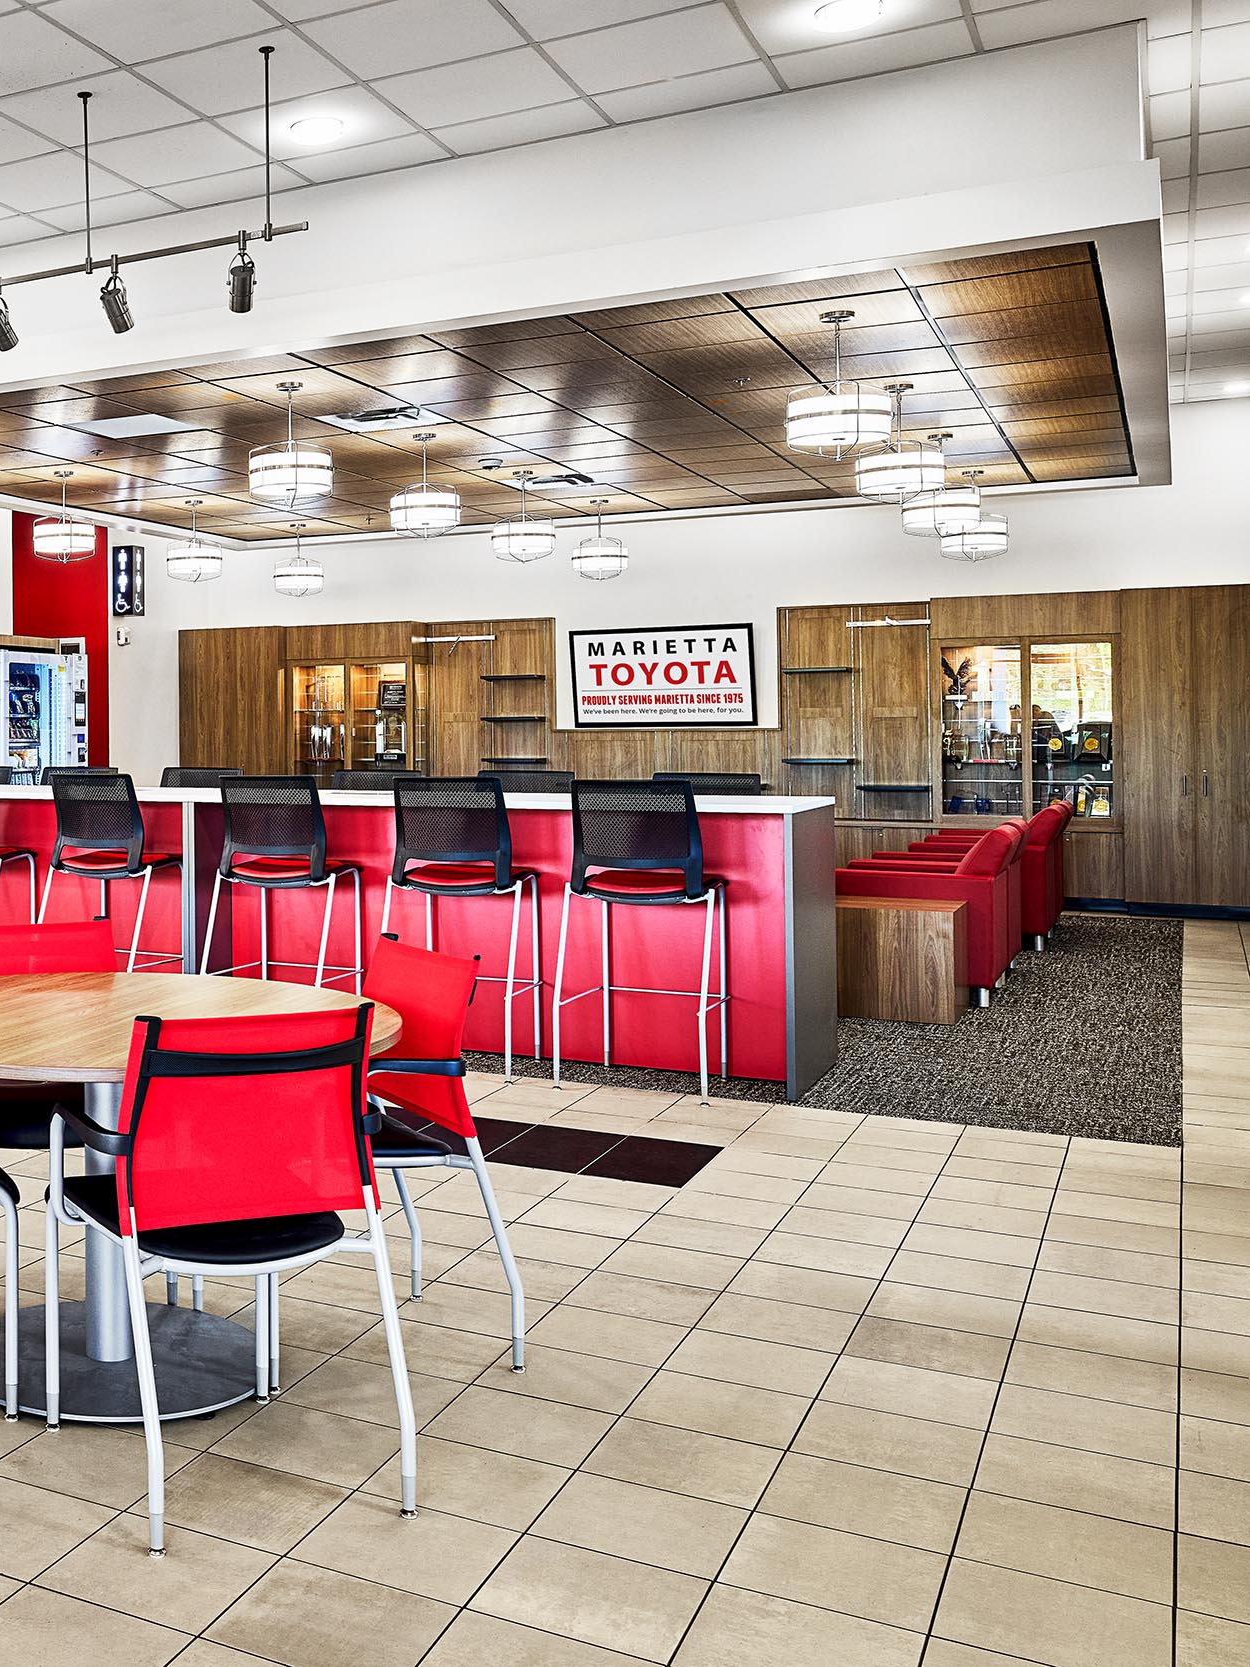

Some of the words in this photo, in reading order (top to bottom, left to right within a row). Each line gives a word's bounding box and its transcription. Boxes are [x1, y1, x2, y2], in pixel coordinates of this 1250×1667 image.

[588, 637, 738, 657] MARIETTA
[589, 660, 738, 687] TOYOTA
[582, 695, 617, 706] PROUDLY
[618, 694, 653, 705] SERVING
[654, 693, 695, 705] MARIETTA
[696, 693, 721, 704] SINCE
[723, 693, 744, 704] 1975
[658, 708, 678, 716] going
[716, 706, 728, 714] for
[728, 707, 744, 715] you.
